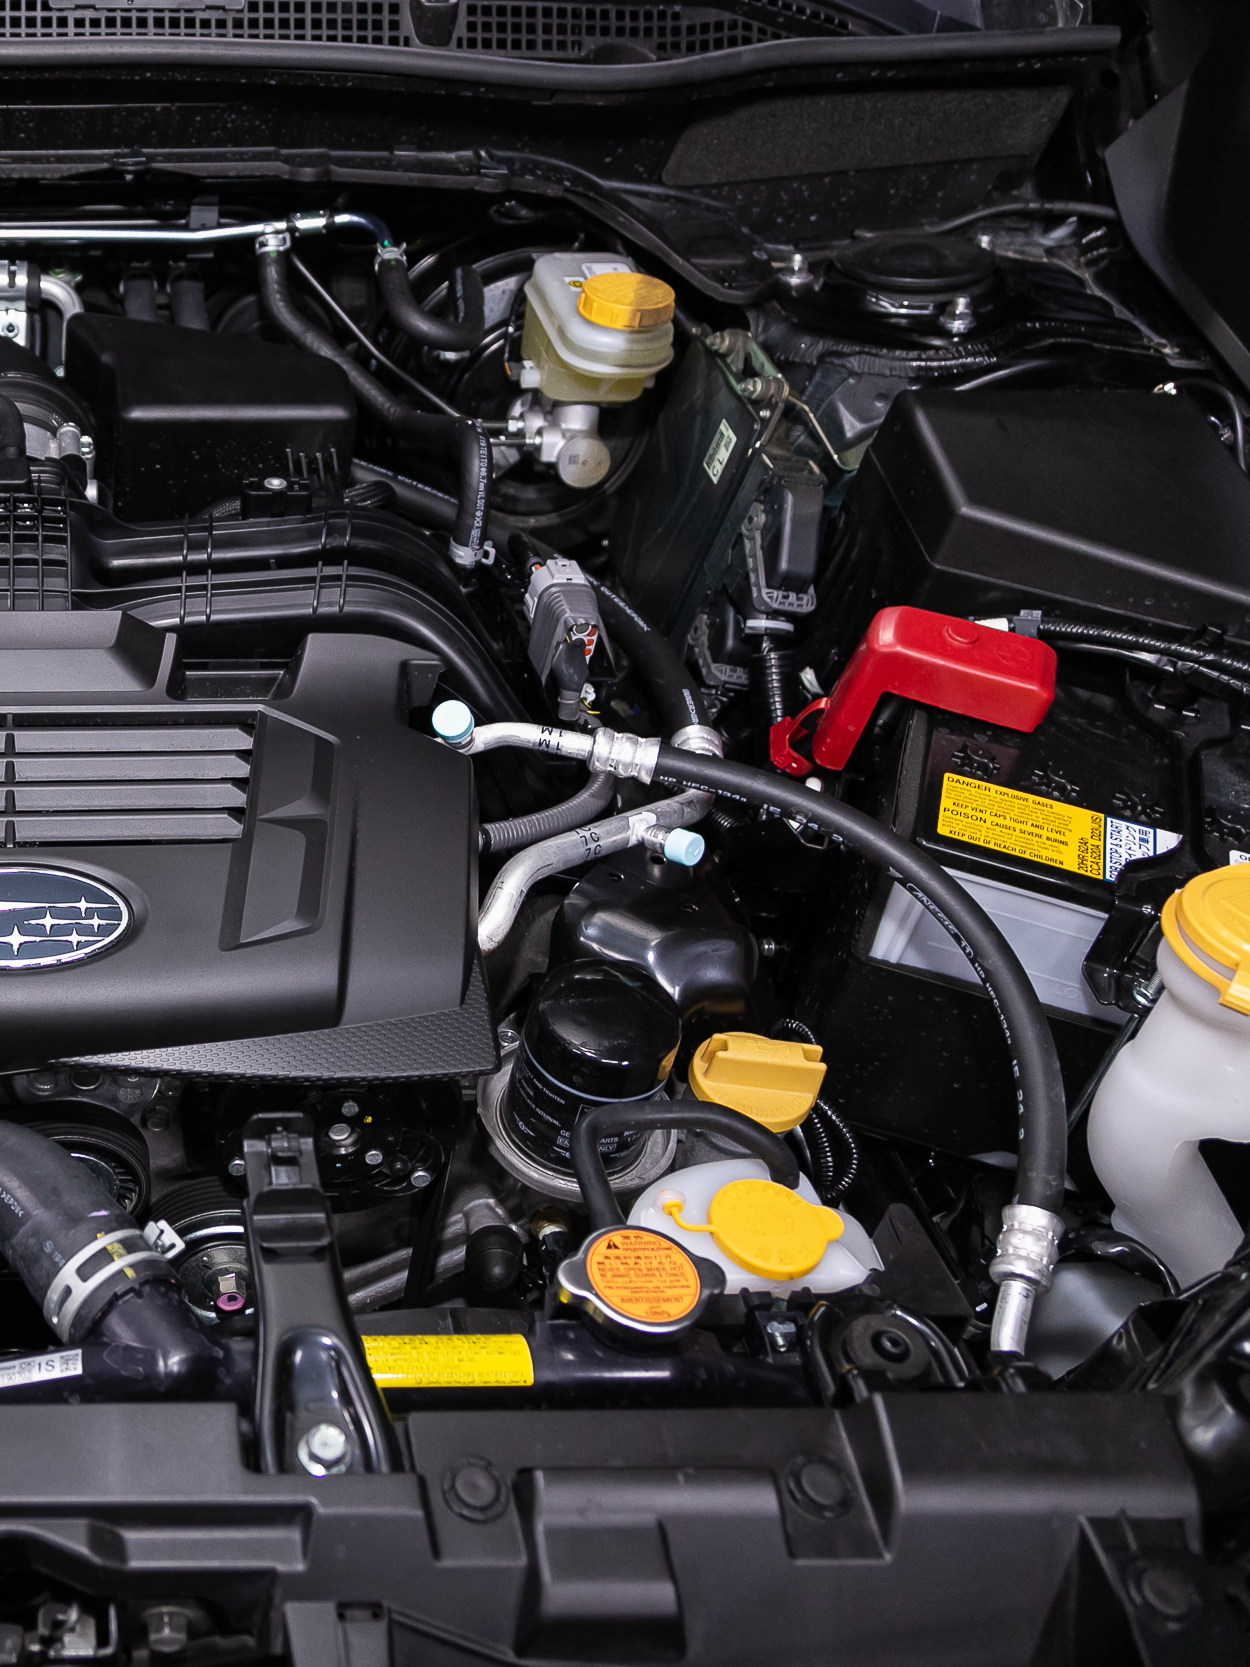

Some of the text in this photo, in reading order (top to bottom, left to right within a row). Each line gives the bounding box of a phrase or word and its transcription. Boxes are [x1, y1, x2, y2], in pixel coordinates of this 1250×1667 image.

[947, 775, 1053, 809] DANGER EXPLOSIVE GASES
[943, 806, 1068, 847] POISON CAUSES SEVERE BURNS
[952, 800, 1066, 836] KEEP VENT CAPS TIGHT AND LEVEL
[1110, 820, 1122, 842] START
[948, 828, 966, 838] KEEP
[967, 833, 981, 843] OUT
[993, 841, 1016, 853] REACH
[1018, 848, 1027, 856] OF
[1028, 851, 1064, 866] CHILDREN
[1110, 848, 1122, 866] STOP
[1078, 854, 1088, 872] 20HR
[1090, 858, 1101, 875] CCA
